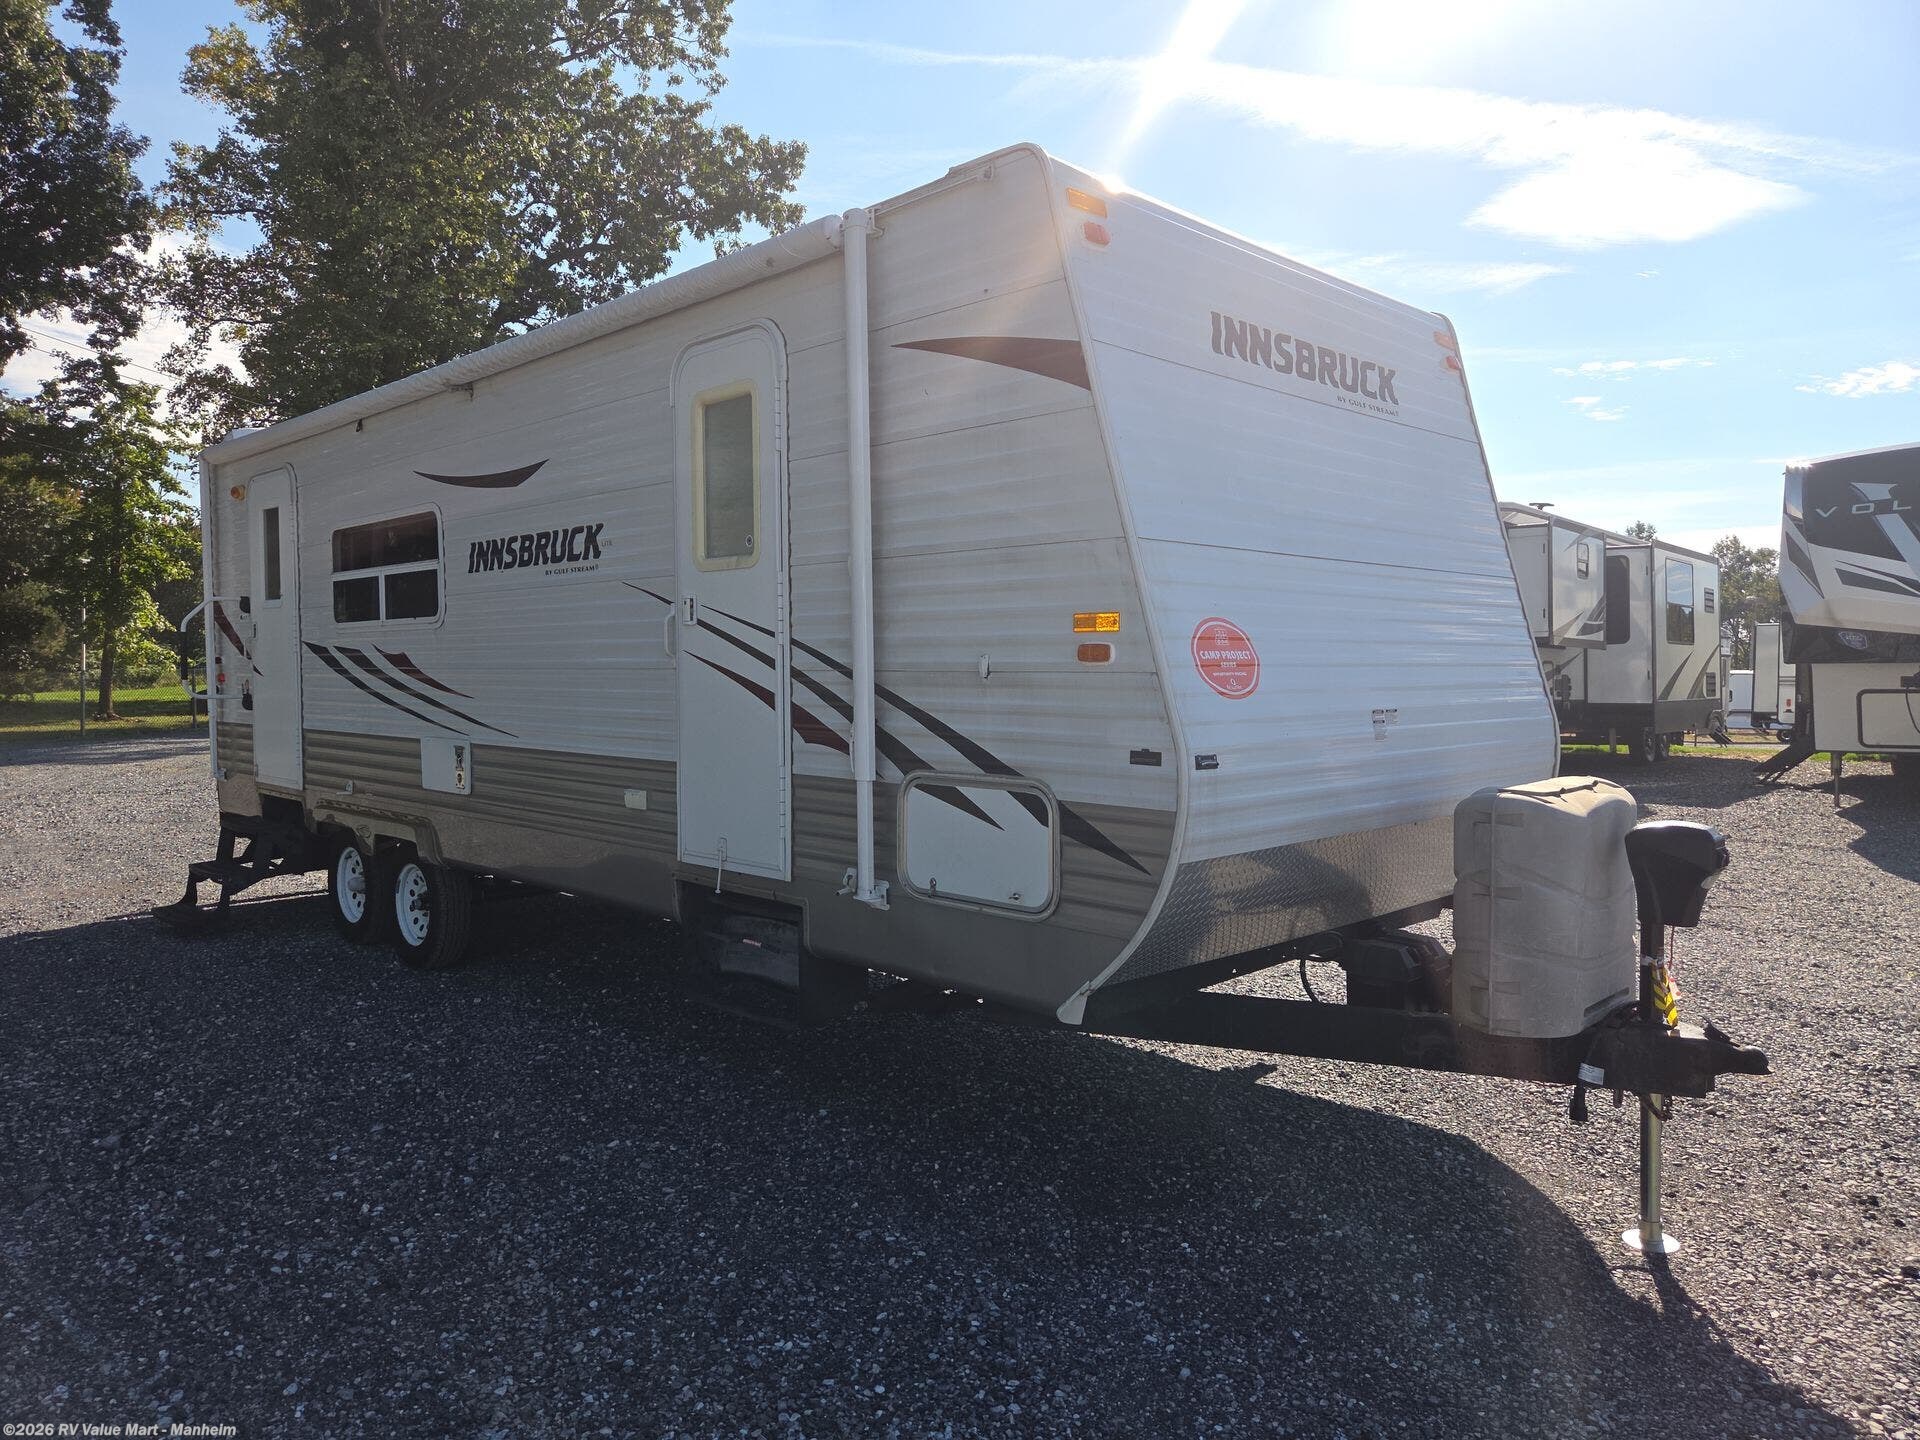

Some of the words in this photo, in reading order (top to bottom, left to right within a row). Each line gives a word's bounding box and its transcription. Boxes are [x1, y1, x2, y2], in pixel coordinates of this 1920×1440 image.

[1210, 311, 1399, 406] INNSBRUCK
[1815, 500, 1912, 518] VOL
[467, 523, 604, 574] INNSBRUCK
[570, 565, 595, 573] STREAM
[1199, 650, 1220, 660] CAMP
[1220, 650, 1251, 661] PROJECT
